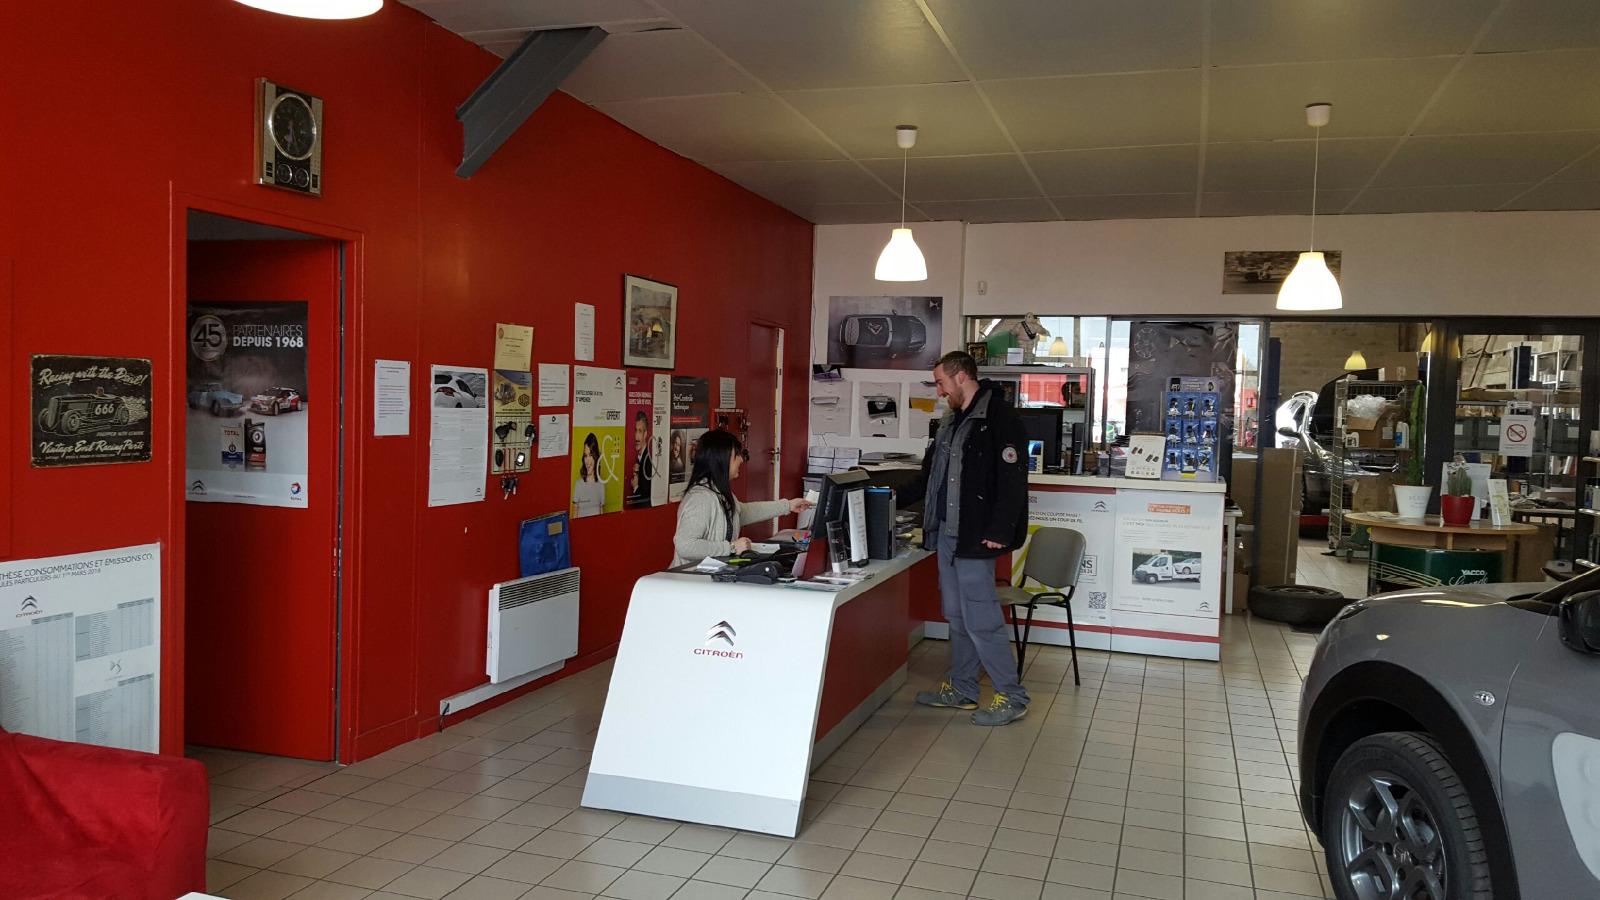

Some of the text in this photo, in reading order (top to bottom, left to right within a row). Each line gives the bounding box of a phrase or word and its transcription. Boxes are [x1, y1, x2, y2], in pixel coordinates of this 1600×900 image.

[191, 323, 223, 349] 45
[232, 324, 304, 337] PARTENAIRES
[232, 336, 305, 348] DEPUIS 1968
[39, 367, 75, 387] Racing
[95, 403, 115, 416] 666
[224, 429, 240, 437] TOTAL
[40, 441, 74, 458] Vintage
[24, 560, 94, 577] CONSOMMATIONS
[95, 558, 103, 568] ET
